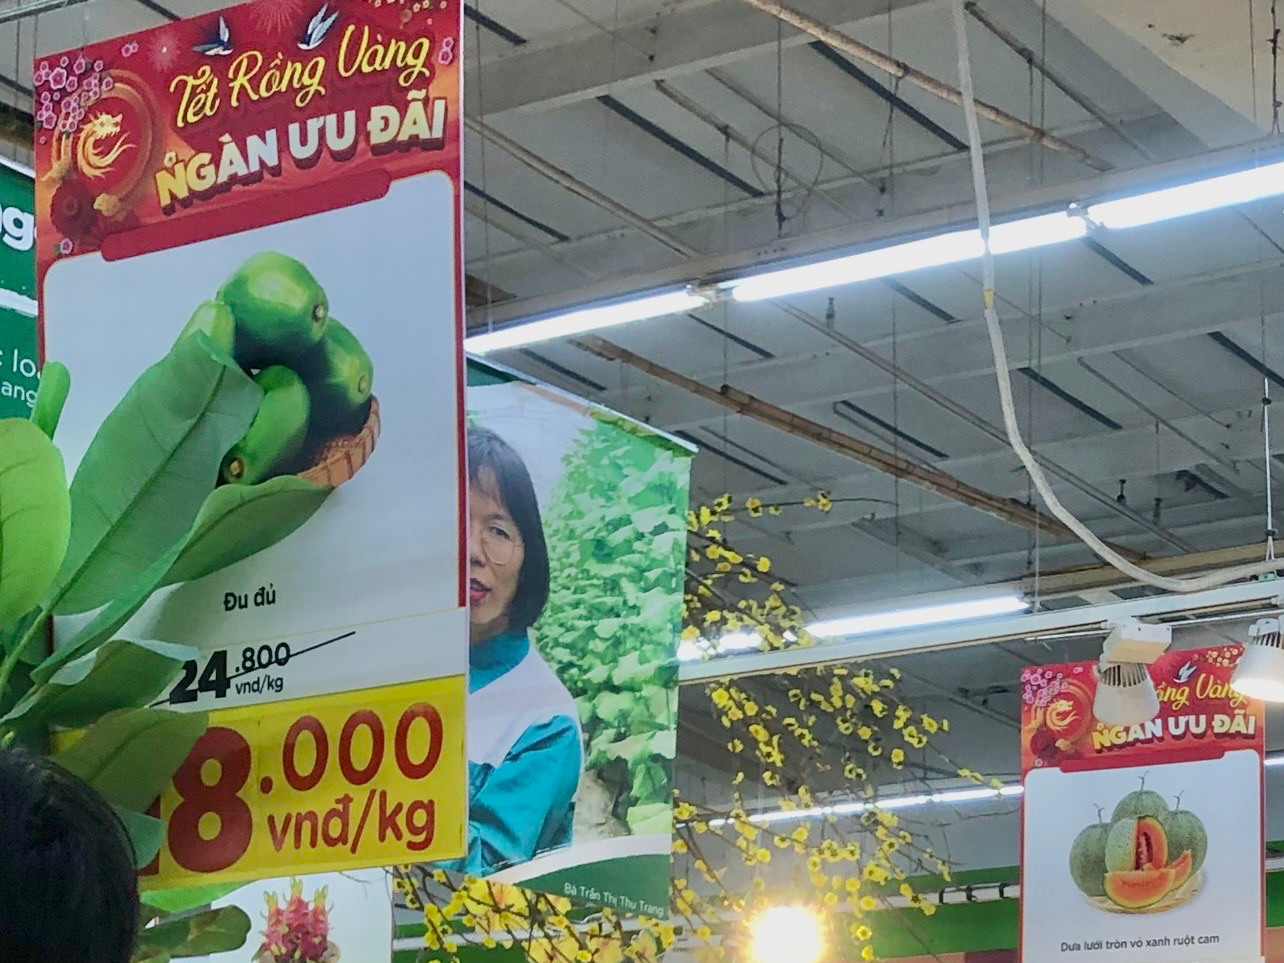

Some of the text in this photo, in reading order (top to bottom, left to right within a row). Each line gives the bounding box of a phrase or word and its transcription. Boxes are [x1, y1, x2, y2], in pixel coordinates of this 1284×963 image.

[170, 24, 430, 127] Tết Rồng Vàng
[155, 89, 446, 207] NGÀN ƯU ĐÃI
[224, 583, 276, 611] Đu đủ
[1154, 684, 1190, 711] ồng
[1168, 714, 1206, 736] ƯU
[1212, 708, 1256, 735] ĐÃI
[137, 702, 443, 876] 8.000
[267, 788, 435, 854] vnđ/kg
[1061, 942, 1081, 952] Dưa
[1084, 939, 1102, 950] lưới
[1105, 938, 1127, 949] tròn
[1146, 936, 1170, 947] xanh
[1173, 935, 1195, 947] ruột
[1197, 935, 1220, 944] cam
